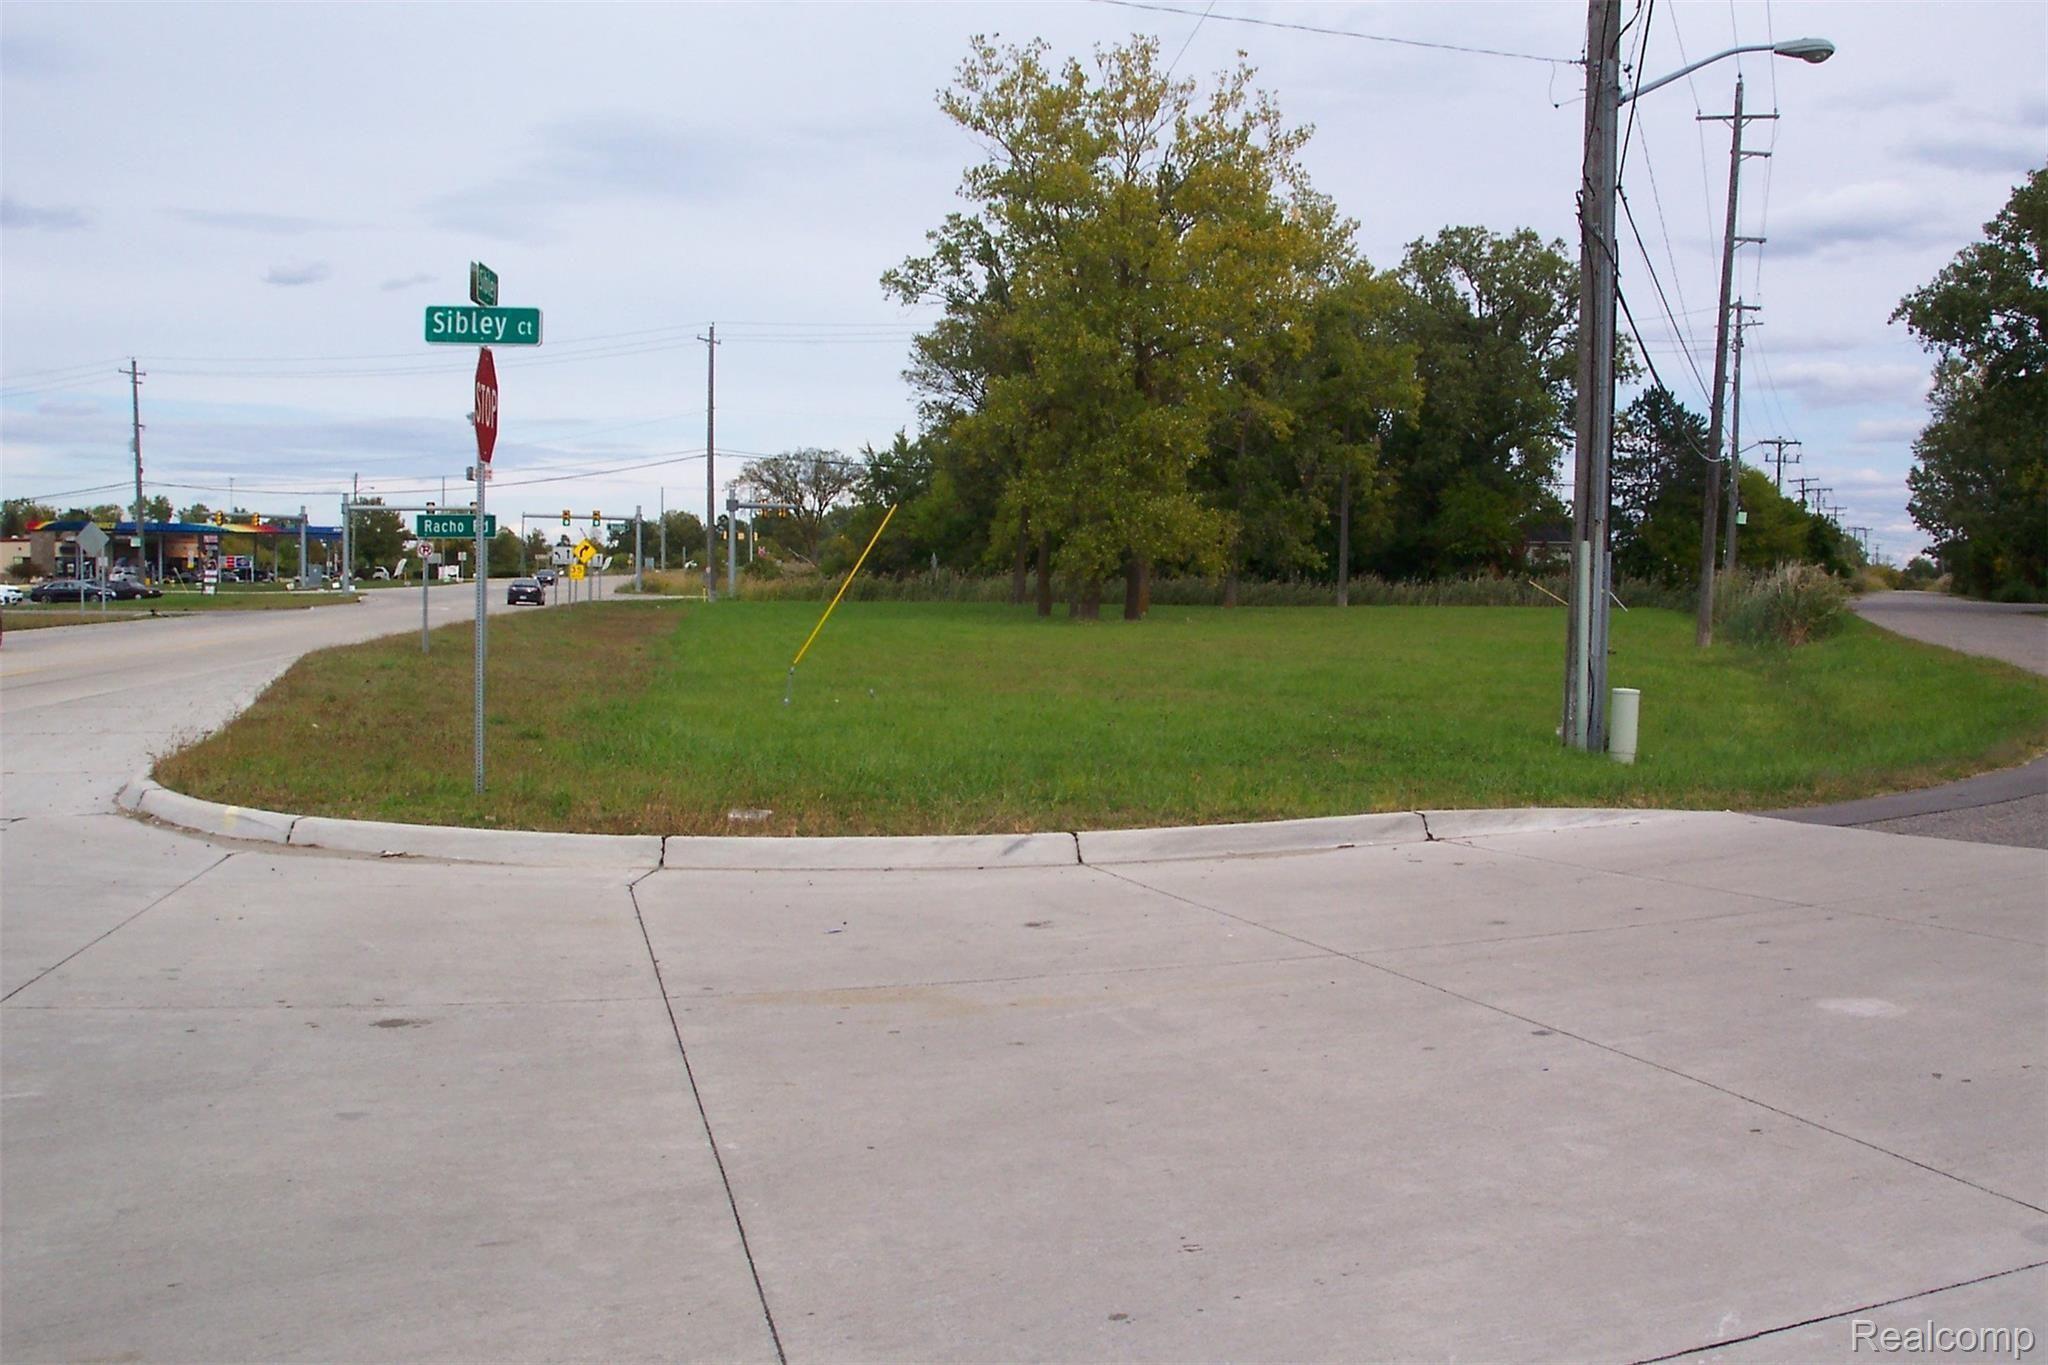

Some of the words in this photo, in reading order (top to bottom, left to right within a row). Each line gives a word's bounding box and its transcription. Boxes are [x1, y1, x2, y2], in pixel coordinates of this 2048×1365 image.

[432, 309, 507, 340] Sibley
[476, 381, 497, 429] STOP
[424, 519, 465, 533] Racho
